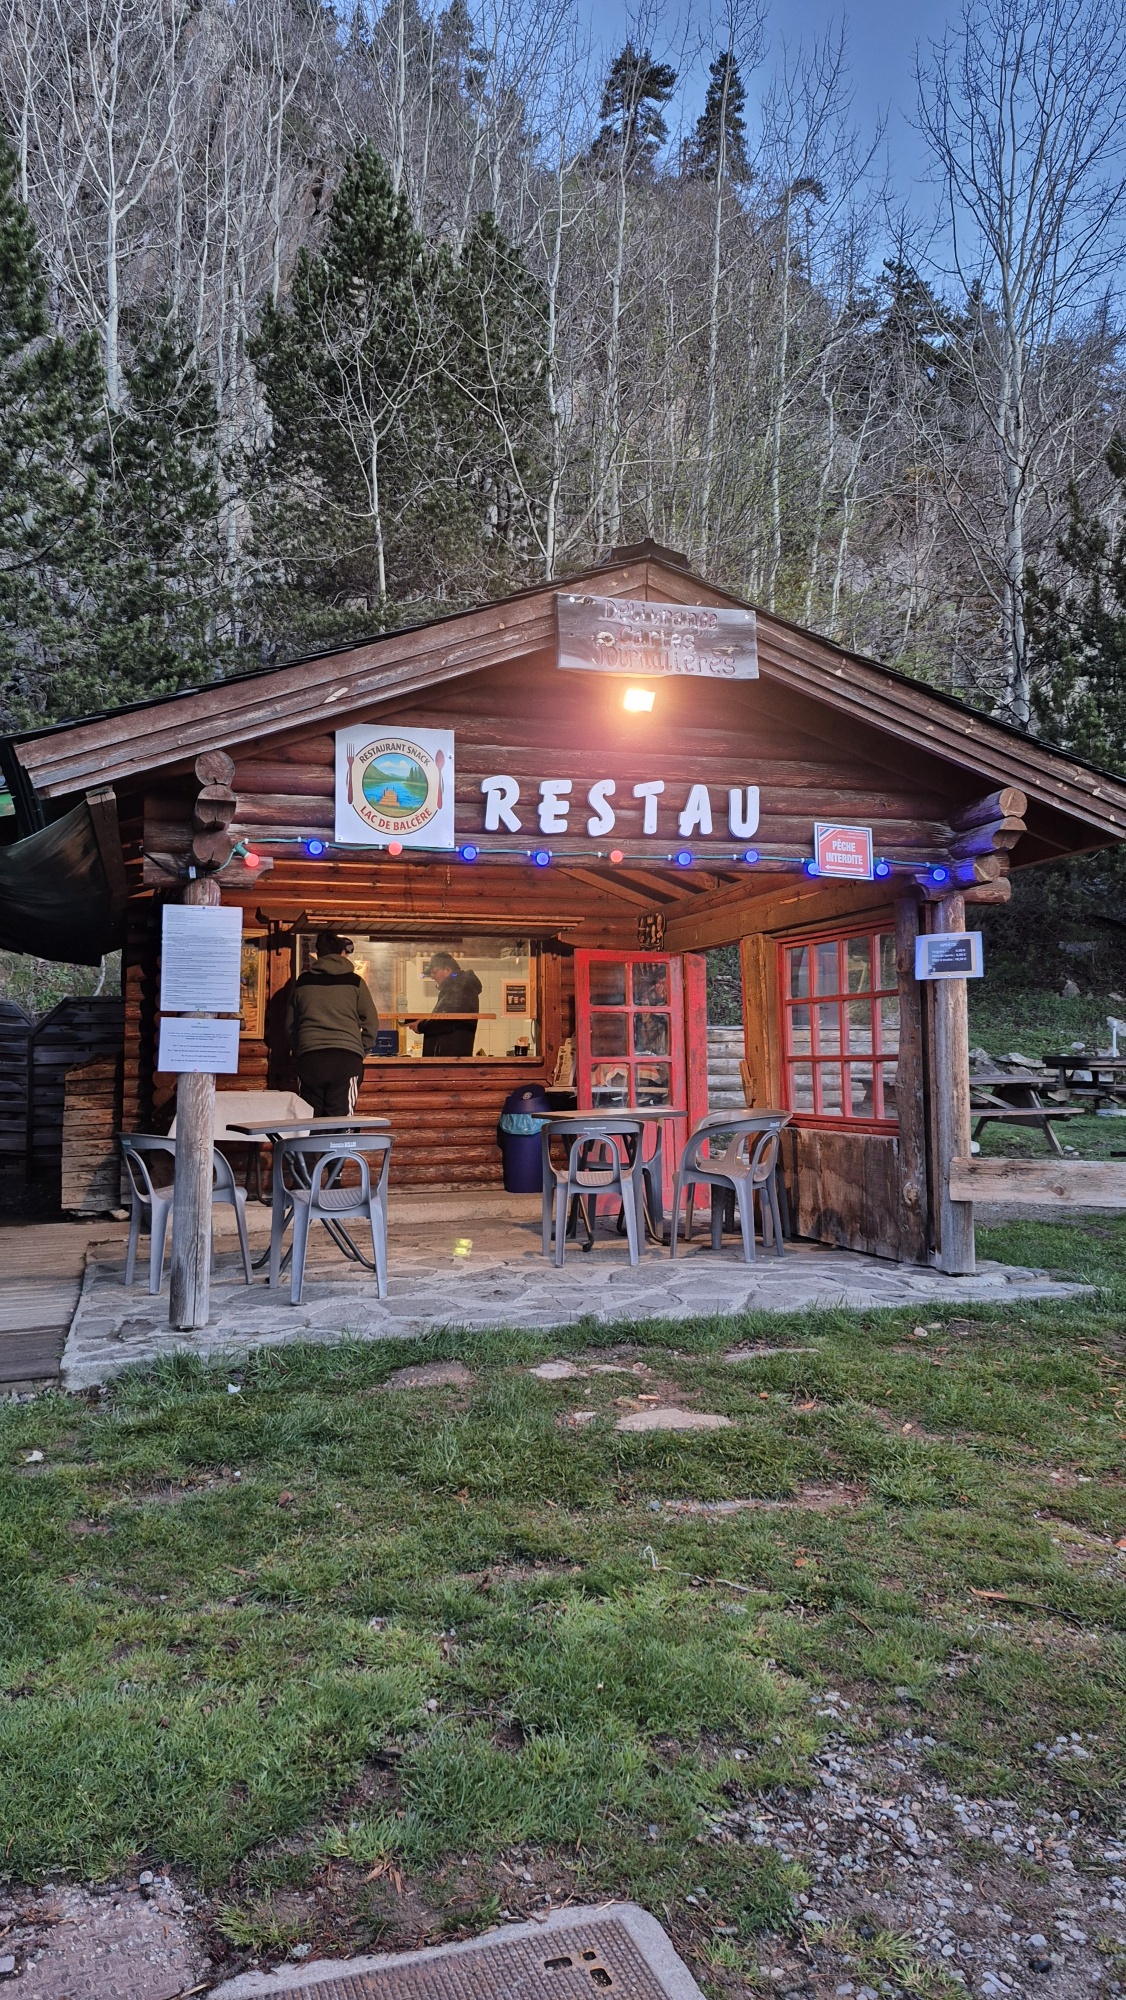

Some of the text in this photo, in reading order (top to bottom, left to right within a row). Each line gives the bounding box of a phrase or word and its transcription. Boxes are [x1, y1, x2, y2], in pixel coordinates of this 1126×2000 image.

[617, 626, 695, 650] Cartes
[358, 743, 431, 767] RESTAURANT SNACK
[360, 805, 433, 831] LAC DE BALCÈRE
[480, 774, 761, 838] RESTAU
[832, 839, 856, 852] PÊCHE
[826, 852, 863, 865] INTERDITE
